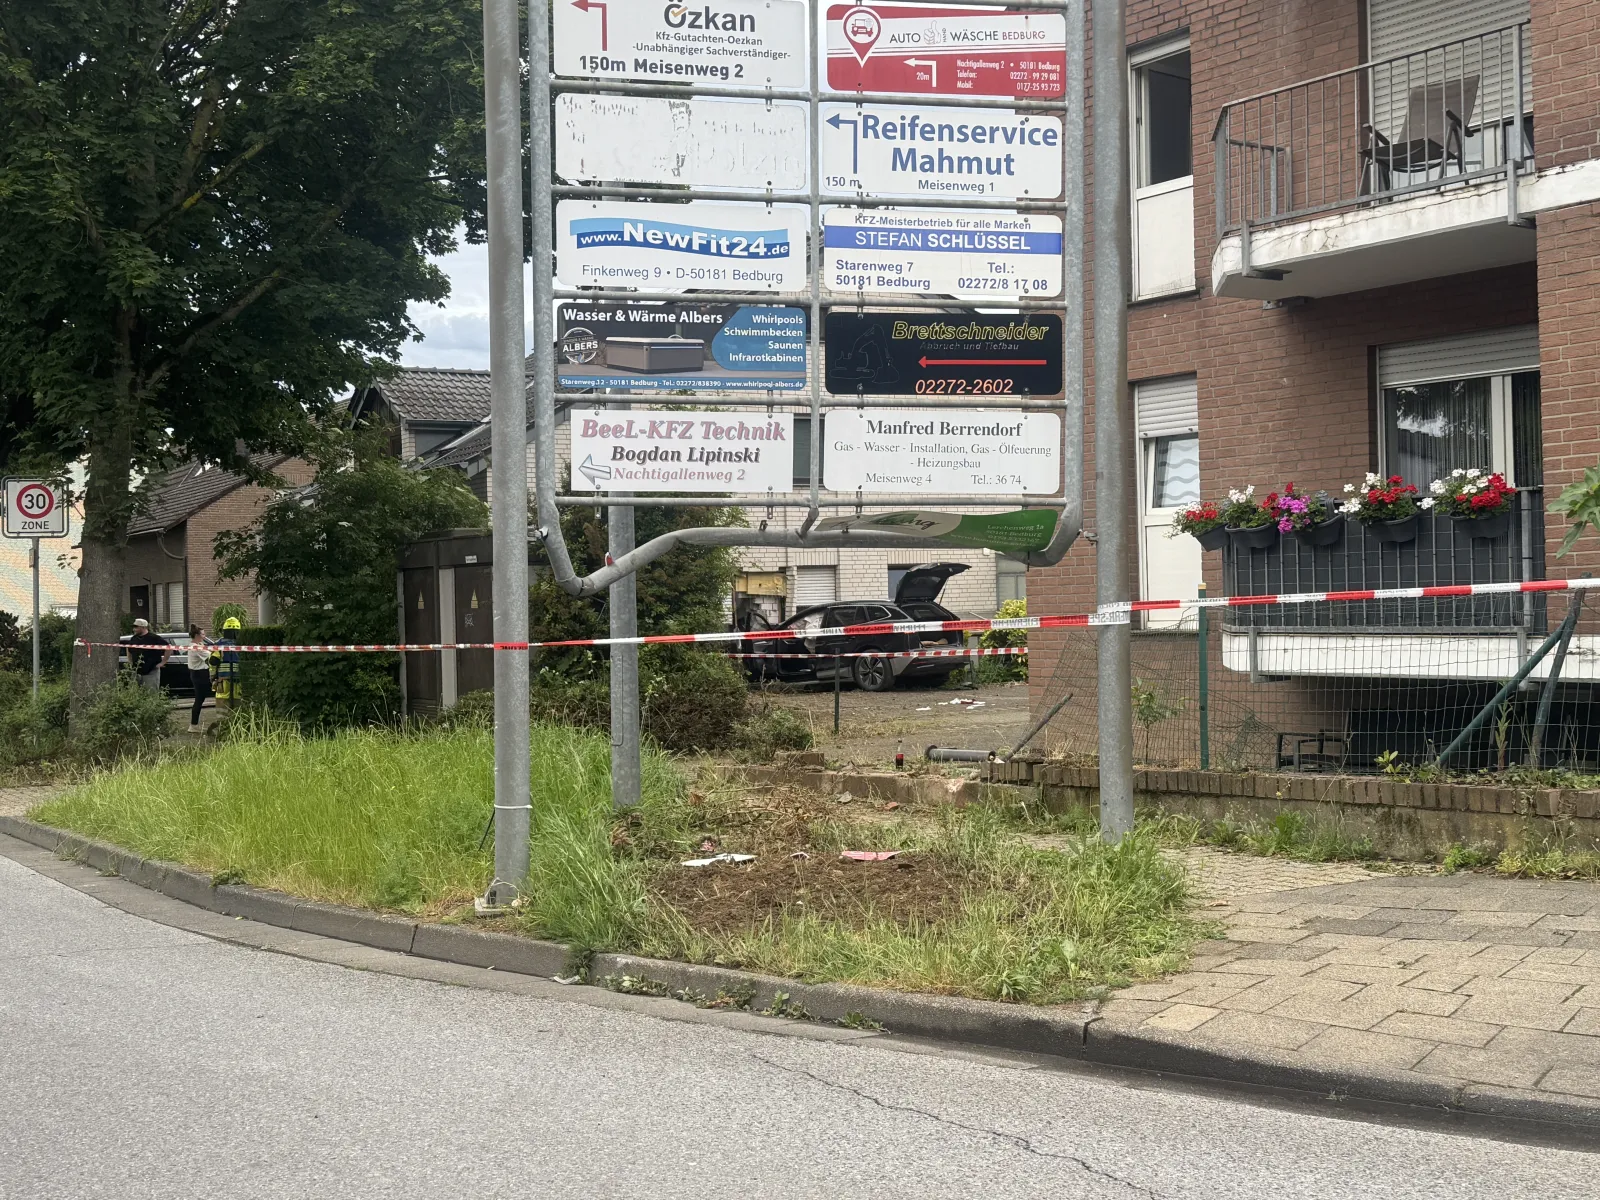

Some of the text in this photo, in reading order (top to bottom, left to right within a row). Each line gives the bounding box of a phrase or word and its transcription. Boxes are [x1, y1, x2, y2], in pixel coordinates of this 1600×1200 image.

[664, 0, 756, 33] Özkan
[656, 31, 763, 46] Kfz-Gutachten-Oezkan
[889, 33, 921, 44] AUTO
[950, 29, 999, 42] WÄSCHE
[1002, 30, 1046, 41] BEDBURG
[632, 42, 791, 60] -Unabhängiger Sachverständiger-
[579, 55, 744, 80] 150m Meisenweg 2
[957, 59, 1060, 71] Nachtigallenweg 2 50181 Bedburg
[916, 72, 930, 81] 20m
[957, 70, 977, 78] Telefon:
[1010, 72, 1027, 80] 02272
[1032, 72, 1040, 80] 99
[1049, 73, 1060, 81] 081
[957, 81, 973, 89] Mobil:
[1040, 83, 1048, 91] 93
[1049, 83, 1060, 91] 723
[862, 114, 1058, 147] Reifenservice
[891, 147, 1015, 176] Mahmut
[825, 177, 860, 188] 150 m
[918, 179, 995, 194] Meisenweg 1
[855, 215, 1031, 231] KFZ-Meisterbetrieb für alle Marken
[581, 222, 789, 257] www.NewFit24.de
[855, 231, 1031, 250] STEFAN SCHLÜSSEL
[582, 264, 783, 284] Finkenweg 9 D-50181 Bedburg
[835, 259, 914, 274] Starenweg 7
[987, 262, 1015, 274] Tel.:
[835, 274, 931, 290] 50181 Bedburg
[957, 277, 1048, 290] 02272/8 17 08
[563, 308, 723, 324] Wasser & Wärme Albers
[752, 313, 803, 327] Whirlpools
[724, 327, 803, 337] Schwimmbecken
[892, 321, 1049, 341] Brettschneider
[563, 341, 598, 352] ALBERS
[768, 341, 803, 350] Saunen
[920, 341, 1020, 351] Abbruch und Tiefbau
[729, 352, 803, 363] Infrarotkabinen
[630, 380, 658, 388] Bedburg
[915, 379, 1014, 394] 02272-2602
[580, 419, 786, 441] BeeL-KFZ Technik
[866, 419, 1023, 437] Manfred Berrendorf
[611, 446, 760, 466] Bogdan Lipinski
[834, 441, 854, 452] Gas
[864, 442, 900, 454] Wasser
[910, 443, 968, 455] Installation,
[971, 444, 990, 455] Gas
[999, 443, 1051, 457] Ölfeuerung
[917, 457, 981, 470] Heizungsbau
[614, 467, 746, 483] Nachtigallenweg 2
[865, 473, 932, 486] Meisenweg 4
[971, 475, 992, 485] Tel.:
[24, 494, 46, 509] 30
[21, 521, 50, 530] ZONE
